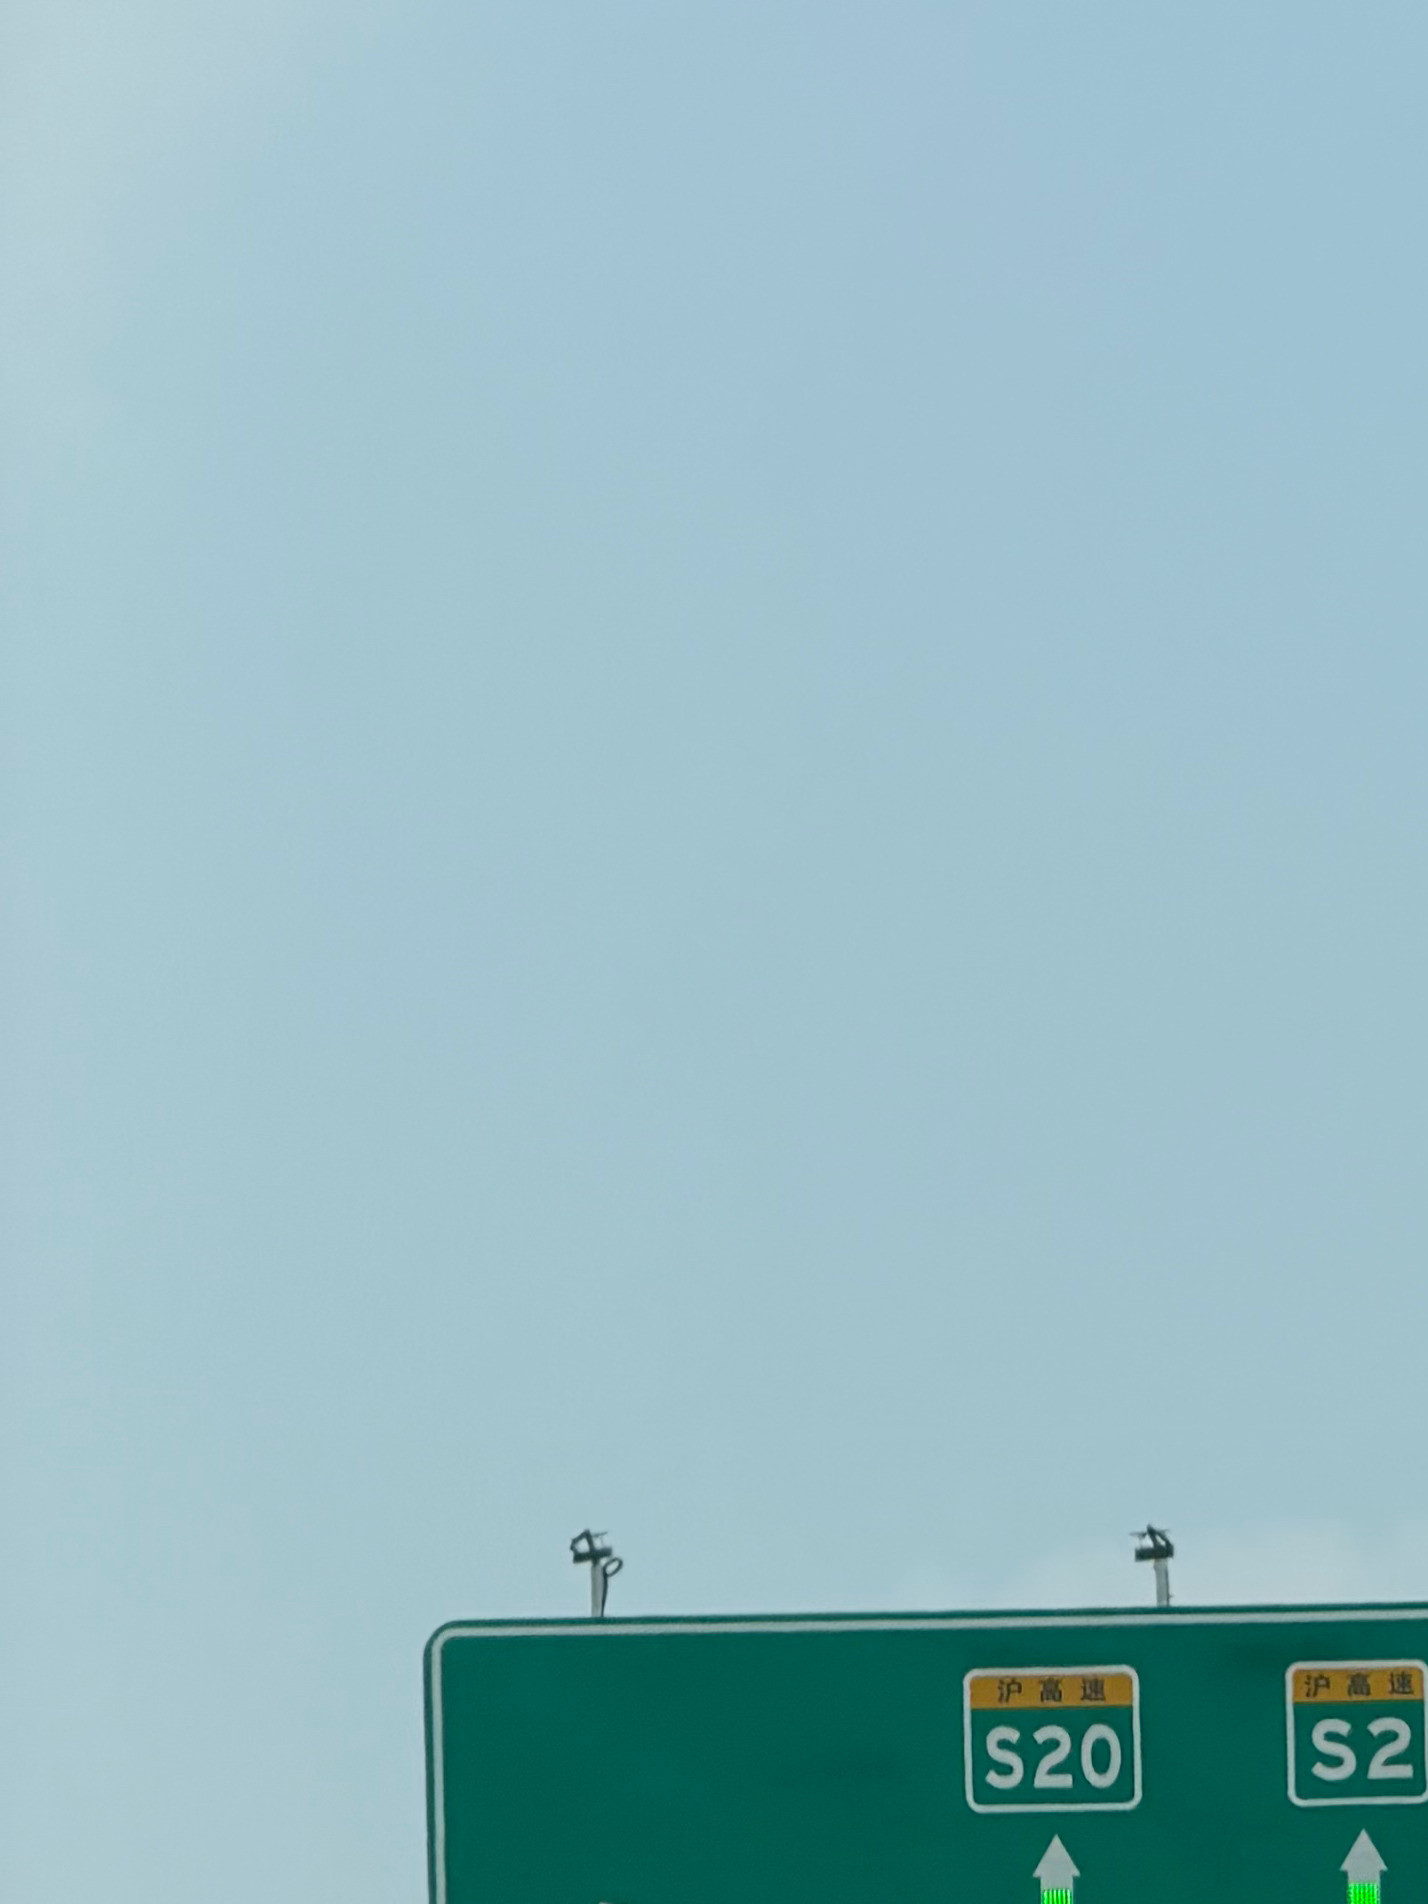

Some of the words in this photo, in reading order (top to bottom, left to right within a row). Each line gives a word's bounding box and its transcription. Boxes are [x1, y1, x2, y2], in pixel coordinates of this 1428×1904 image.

[996, 1676, 1107, 1704] 沪高速
[1304, 1671, 1417, 1699] 沪高速
[985, 1724, 1122, 1789] S20
[1311, 1717, 1414, 1781] S2
